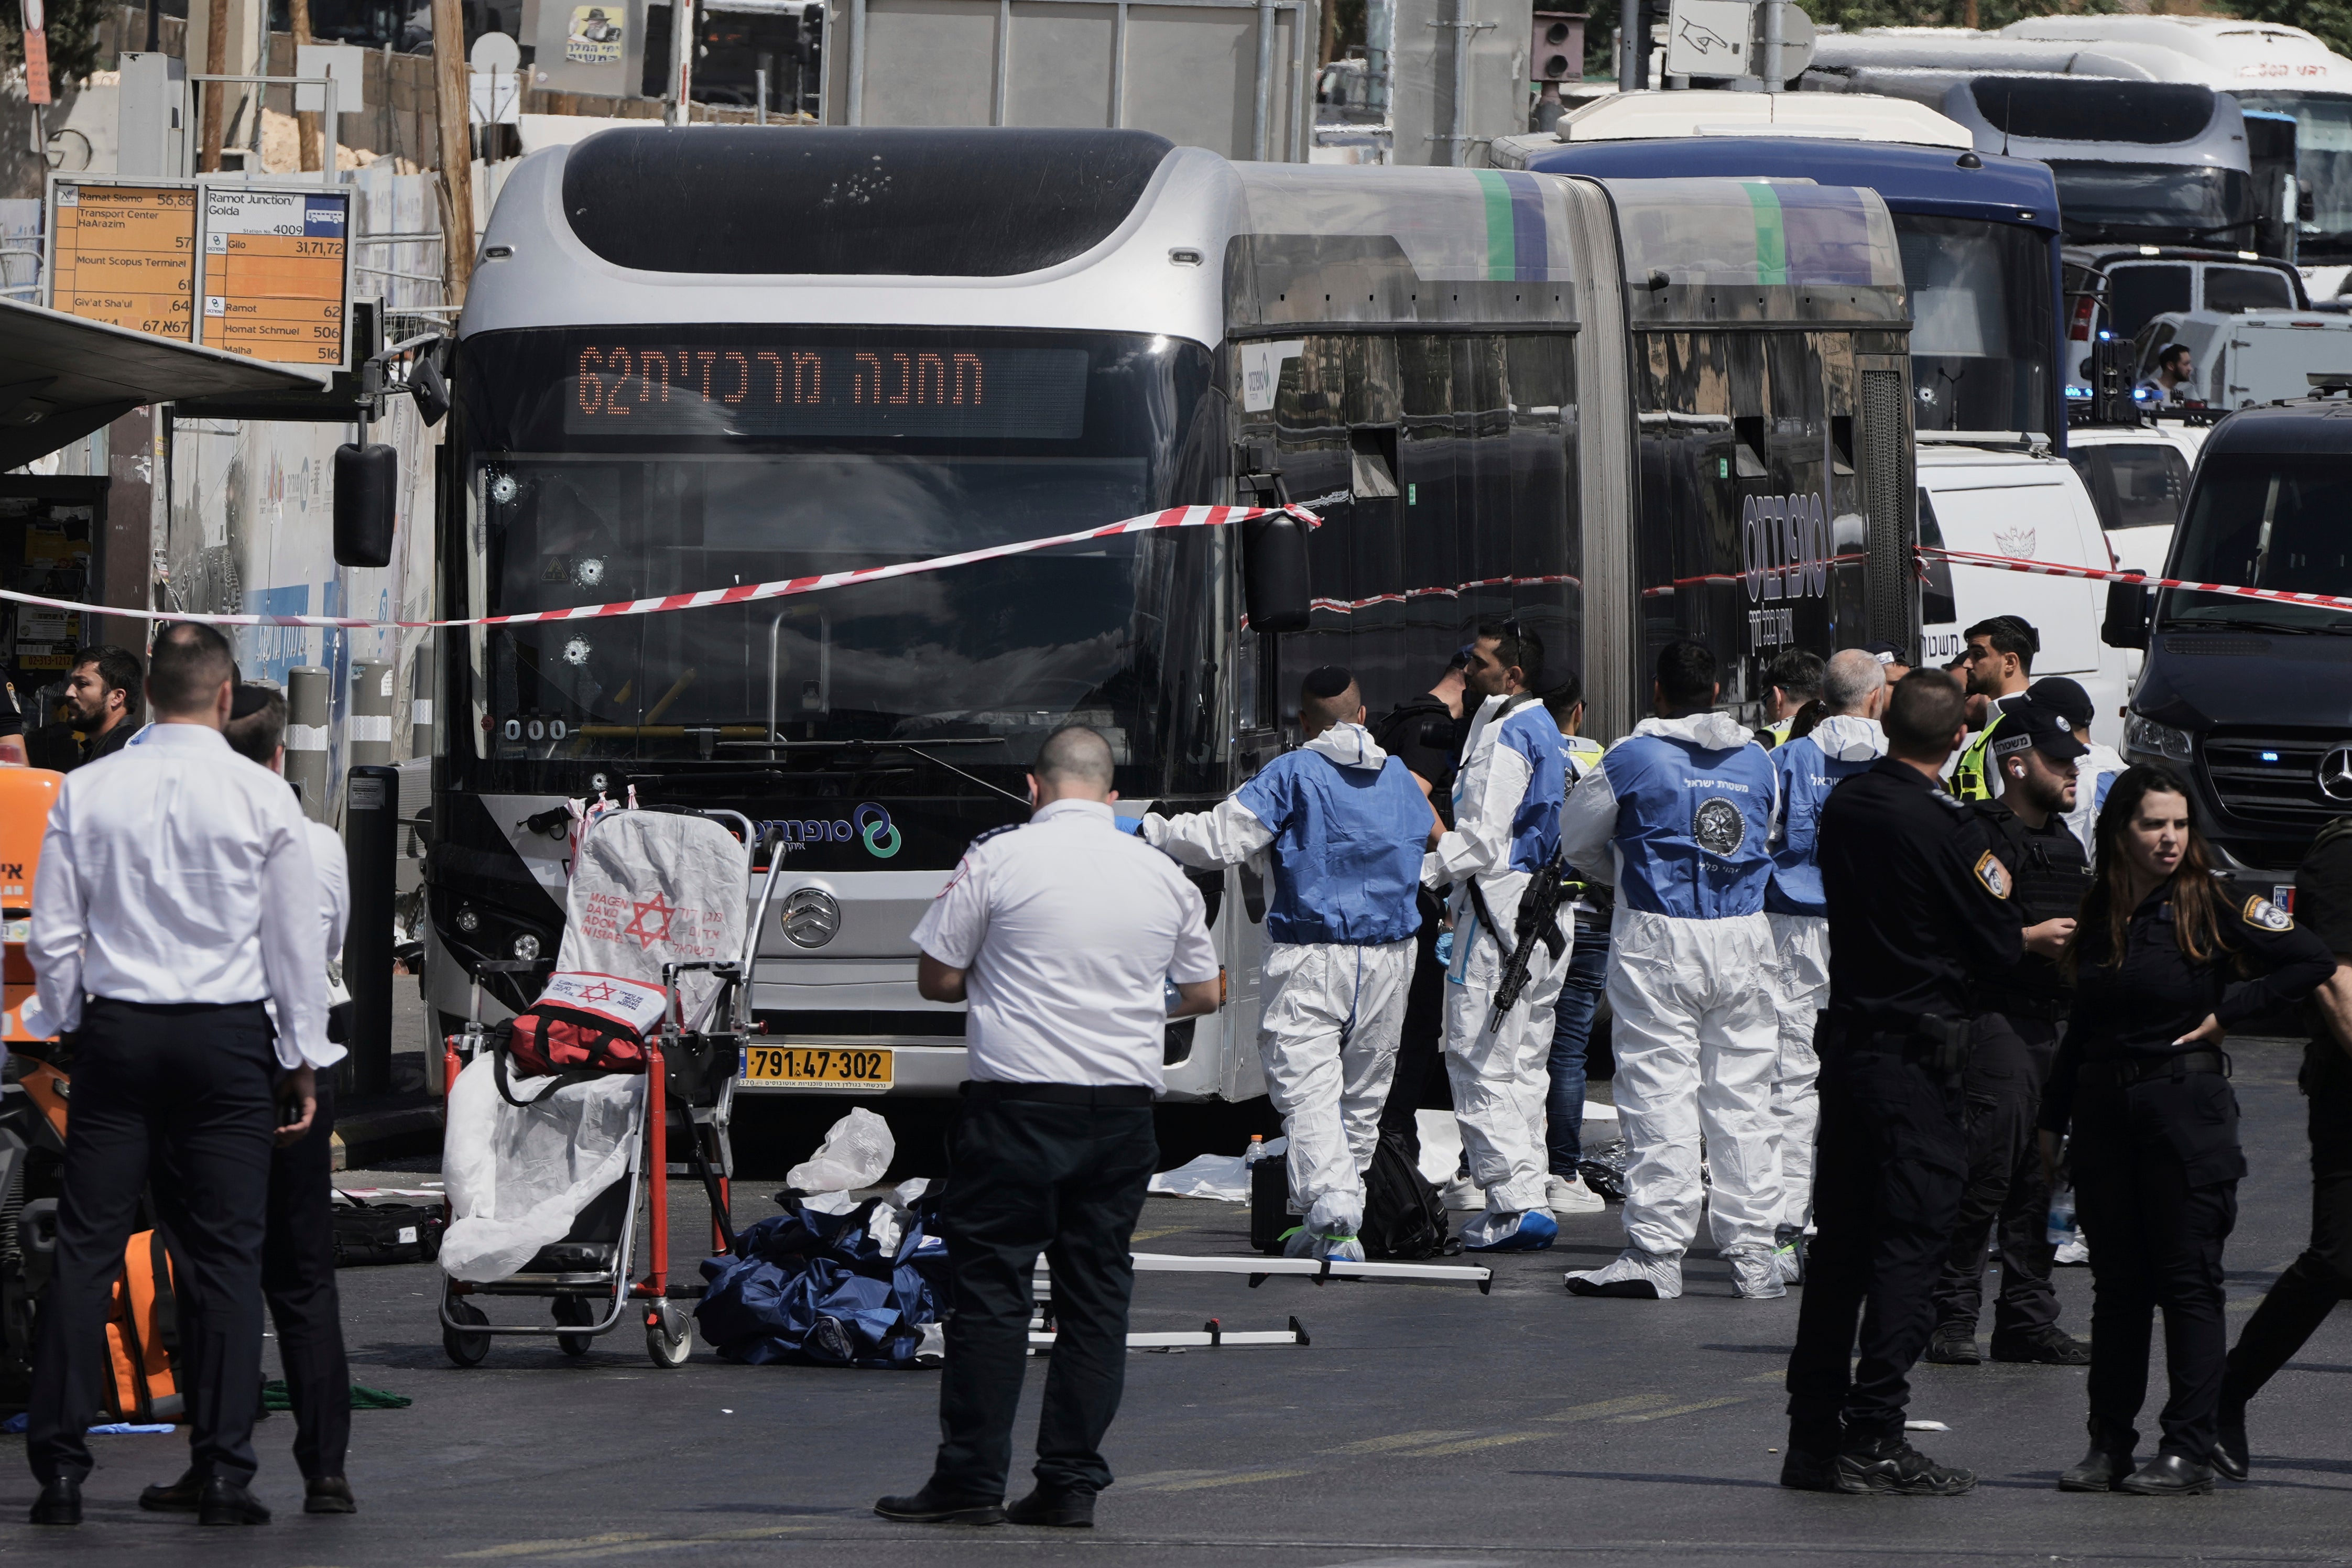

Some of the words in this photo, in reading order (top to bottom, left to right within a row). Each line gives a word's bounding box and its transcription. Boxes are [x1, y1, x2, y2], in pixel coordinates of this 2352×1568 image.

[568, 43, 597, 52] המלך
[80, 193, 110, 202] Ramat
[114, 194, 143, 202] Slomo
[157, 194, 194, 208] 56,86
[210, 193, 244, 203] Ramot
[247, 194, 295, 205] Junction/
[79, 209, 124, 219] Transport
[127, 211, 159, 219] Center
[209, 205, 239, 215] Golda
[79, 220, 125, 228] HaArazim
[274, 225, 302, 235] 4009
[176, 237, 192, 248] 57
[228, 240, 246, 249] Gilo
[296, 242, 343, 256] 31,71,72
[77, 256, 105, 265] Mount
[109, 257, 142, 267] Scopus
[145, 258, 186, 267] Terminal
[179, 279, 191, 290] 61
[75, 298, 101, 307] Giv'at
[105, 299, 132, 308] Sha'ul
[226, 303, 257, 313] Ramot
[324, 306, 340, 317] 62
[259, 326, 299, 335] Schmuel
[314, 327, 339, 339] 506
[225, 346, 252, 354] Malha
[318, 348, 339, 359] 516
[579, 347, 631, 415] 62
[640, 352, 821, 404] מרכזית
[855, 353, 982, 404] תחנה
[1743, 492, 1826, 603] סופרבוס
[1920, 634, 1959, 658] משטר
[29, 656, 70, 666] 02-313-1212
[1996, 736, 2028, 753] משטרה
[1684, 778, 1715, 788] ישראל
[1717, 780, 1749, 793] משטרת
[590, 892, 629, 910] MAGEN
[678, 907, 699, 919] דוד
[702, 911, 723, 924] מגן
[580, 924, 591, 937] IN
[593, 927, 624, 944] ISRAEL
[689, 926, 720, 940] אדום
[672, 941, 715, 957] בישראל
